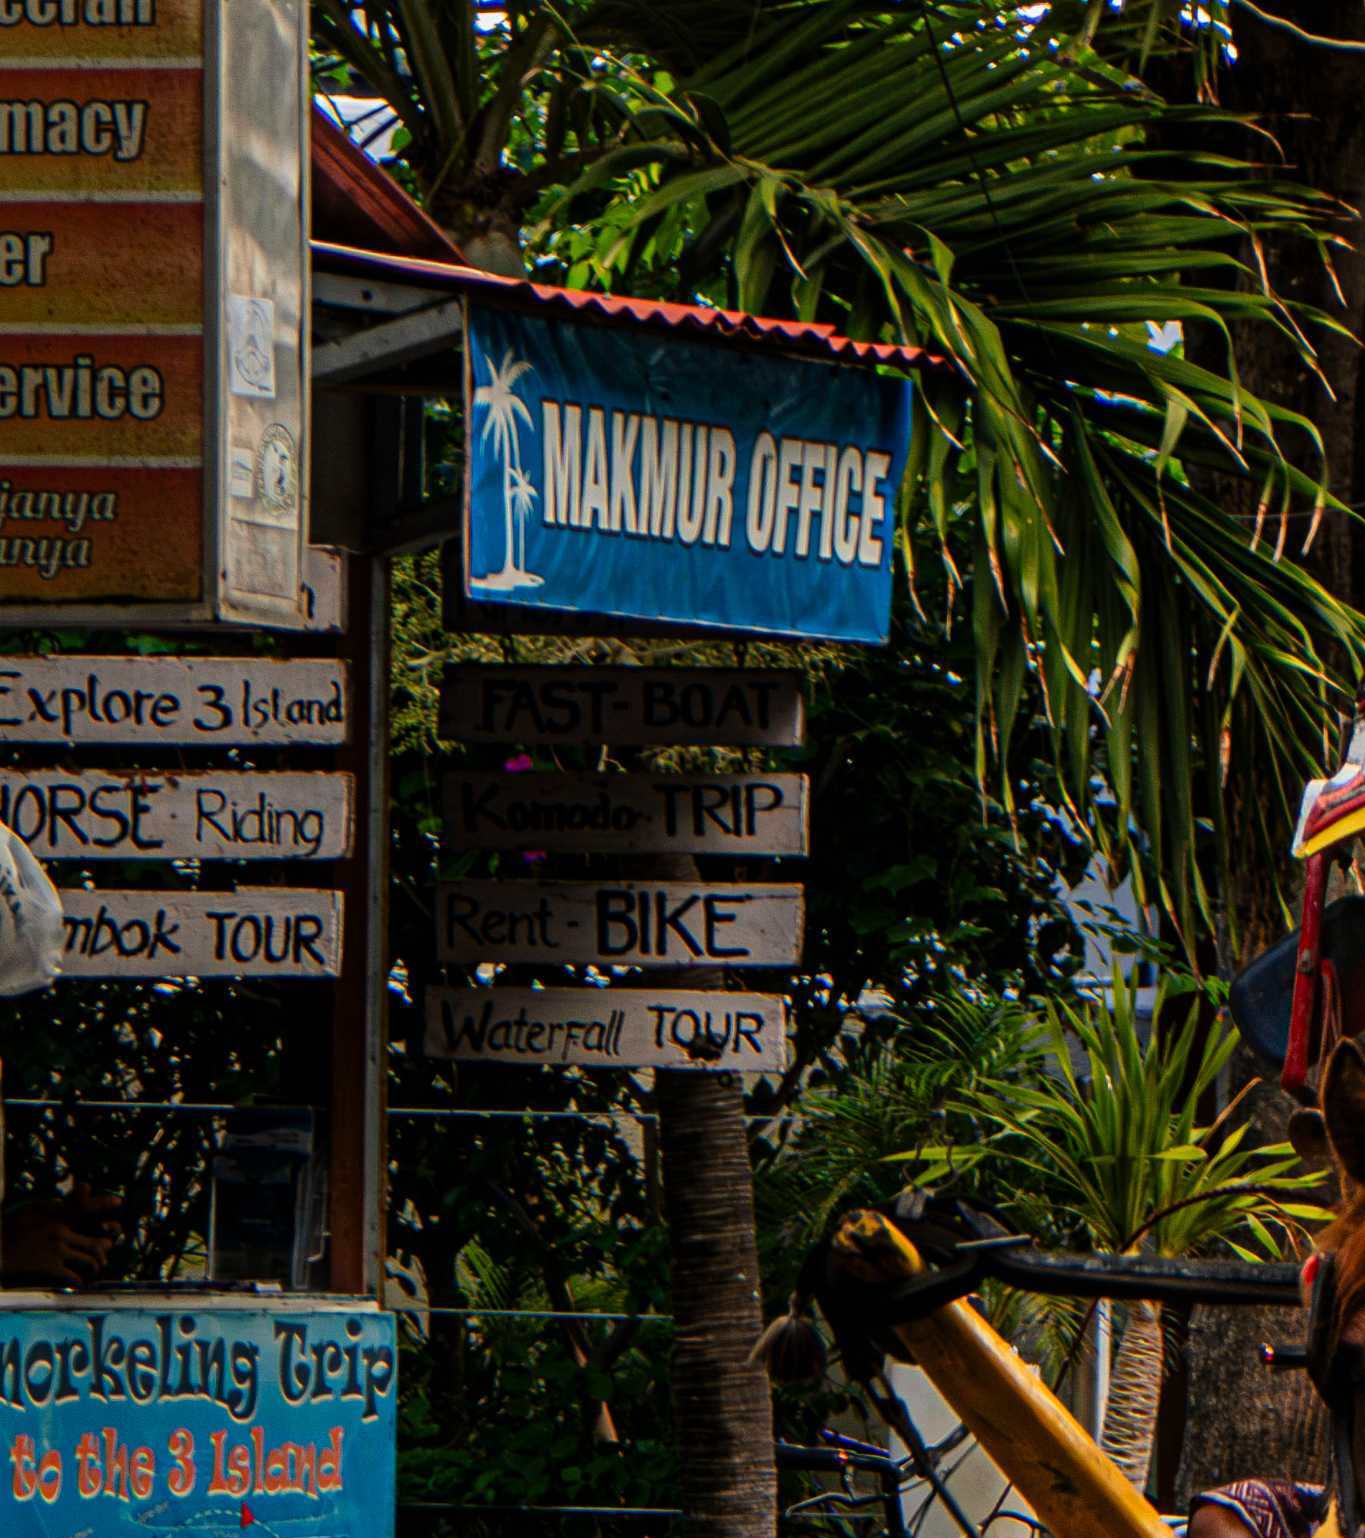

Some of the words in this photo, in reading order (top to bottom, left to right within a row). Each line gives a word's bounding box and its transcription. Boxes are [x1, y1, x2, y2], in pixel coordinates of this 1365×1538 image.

[541, 400, 737, 548] MAKMUR
[746, 431, 892, 567] OFFICE
[193, 684, 233, 731] 3
[242, 679, 344, 728] Island
[195, 789, 325, 857] Riding
[653, 783, 784, 838] TRIP
[206, 911, 326, 965] TOUR
[597, 889, 751, 957] BIKE
[647, 1005, 765, 1056] TOUR
[273, 1319, 394, 1424] Trip
[9, 1432, 62, 1503] to
[75, 1427, 157, 1502] the
[168, 1427, 197, 1497] 3
[207, 1425, 345, 1499] Island
